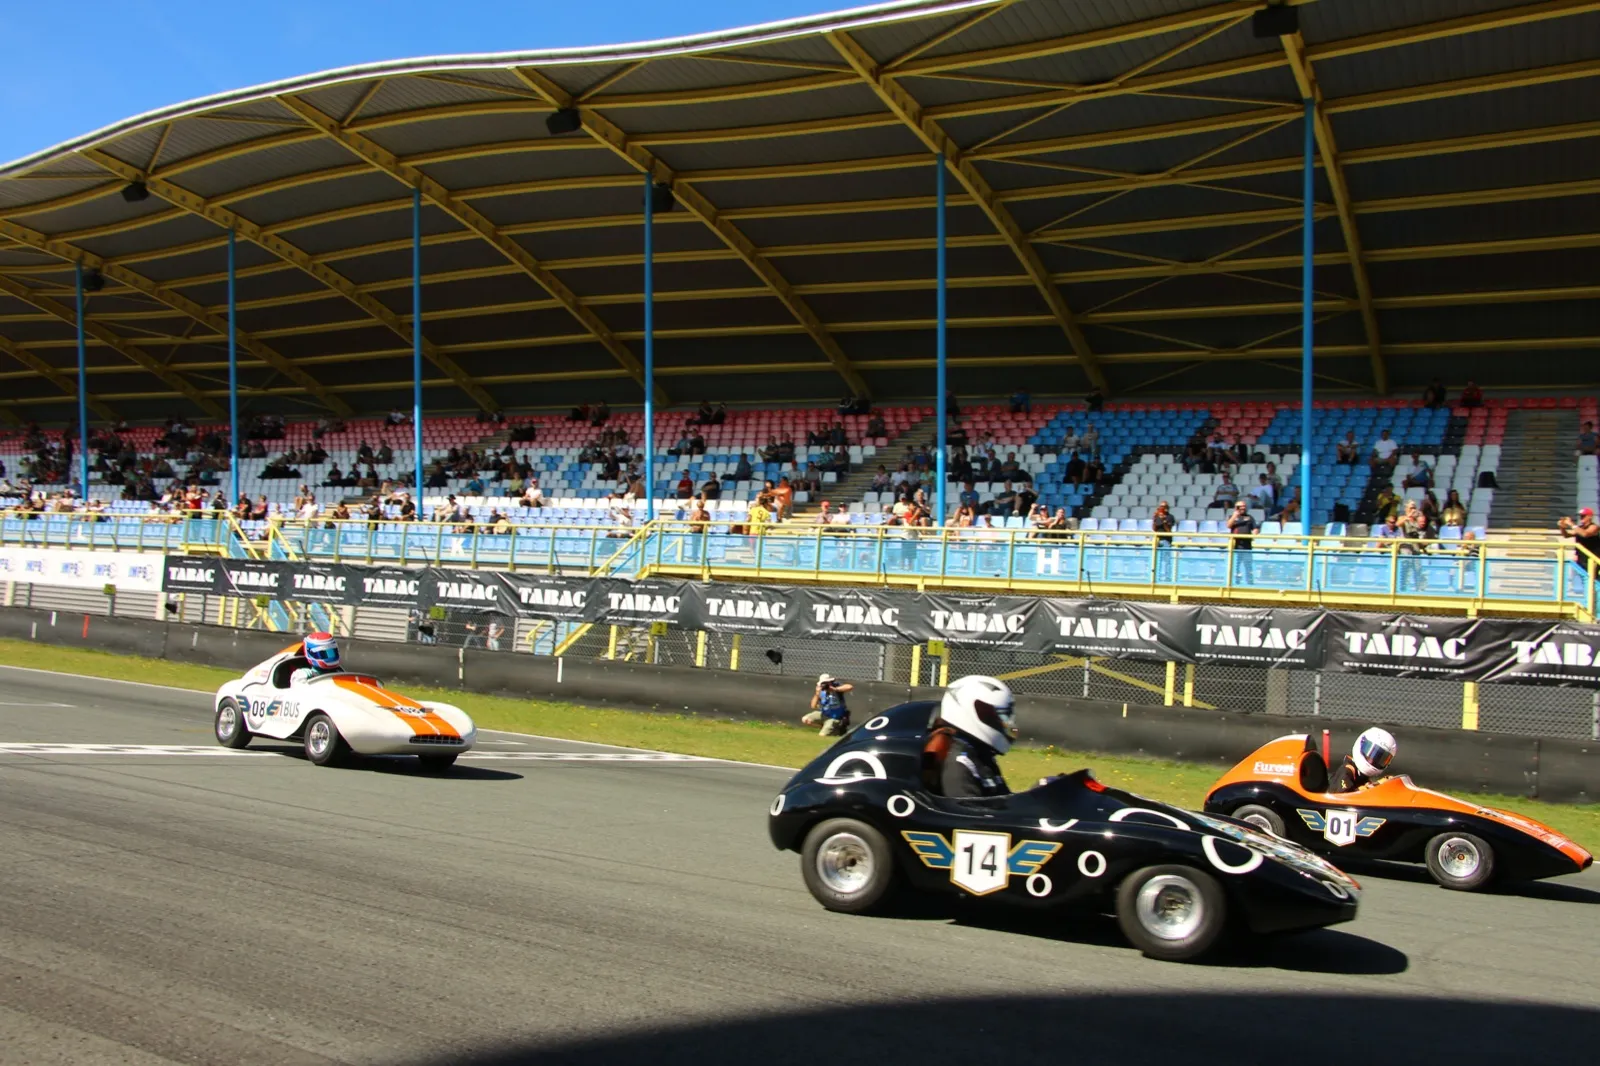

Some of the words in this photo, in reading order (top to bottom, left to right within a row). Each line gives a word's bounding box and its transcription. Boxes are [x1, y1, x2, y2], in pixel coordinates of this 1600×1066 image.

[450, 537, 466, 556] K
[1036, 548, 1060, 575] H
[169, 567, 215, 583] TABAC
[230, 570, 279, 587] TABAC
[293, 574, 346, 591] TABAC
[363, 578, 420, 596] TABAC
[437, 582, 499, 601] TABAC
[518, 587, 586, 608] TABAC
[608, 592, 680, 614] TABAC
[706, 598, 786, 621] TABAC
[812, 603, 899, 627] TABAC
[930, 610, 1025, 634] TABAC
[1056, 616, 1158, 642] TABAC
[1196, 624, 1306, 650] TABAC
[1344, 631, 1466, 660] TABAC
[1511, 641, 1600, 667] TAB
[252, 700, 266, 718] 08
[1330, 817, 1352, 837] 01
[963, 843, 998, 877] 14
